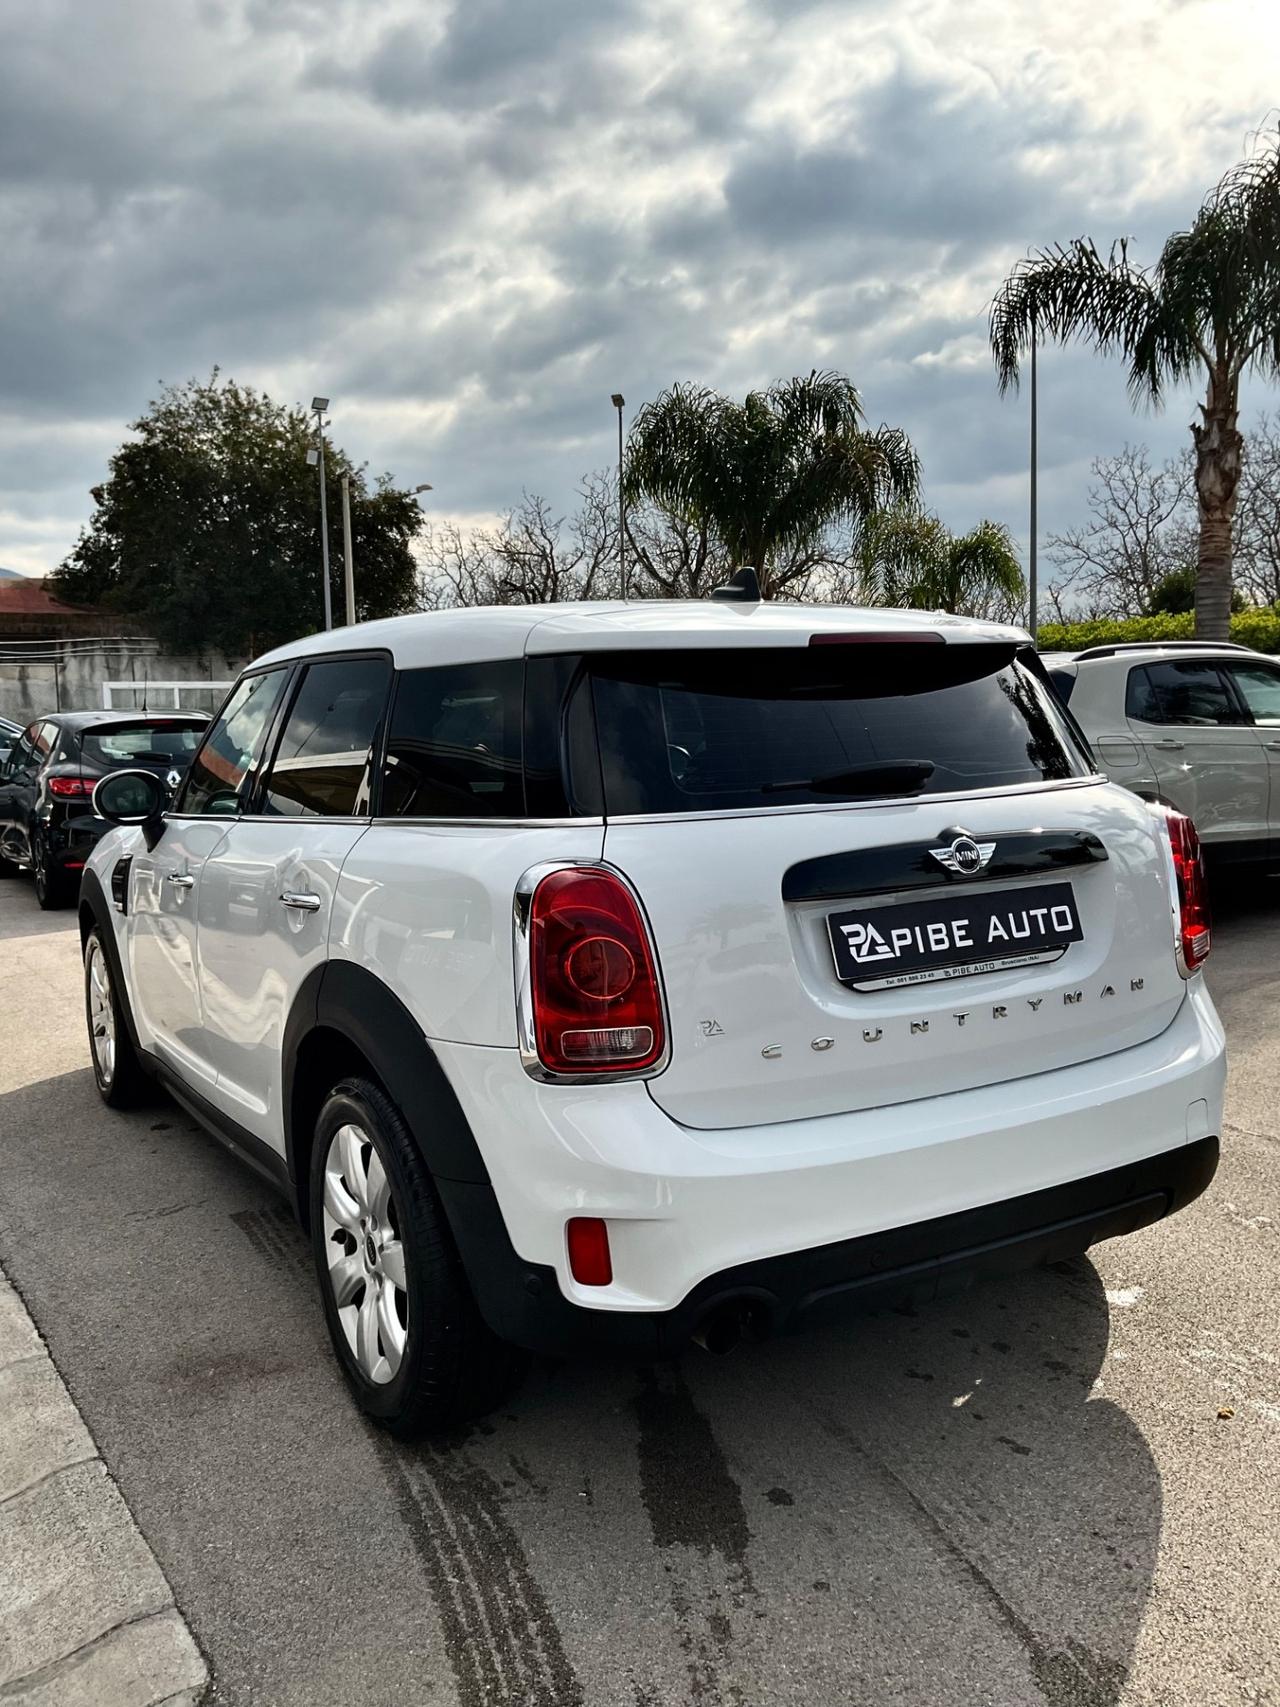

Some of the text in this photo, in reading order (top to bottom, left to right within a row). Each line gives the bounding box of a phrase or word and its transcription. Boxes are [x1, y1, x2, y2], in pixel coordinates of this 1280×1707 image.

[955, 850, 978, 861] MINI
[891, 919, 974, 957] PIBE
[987, 905, 1074, 942] AUTO
[952, 966, 972, 976] PIBE
[974, 962, 996, 972] AUTO
[760, 976, 1145, 1060] COUNTRYMAN
